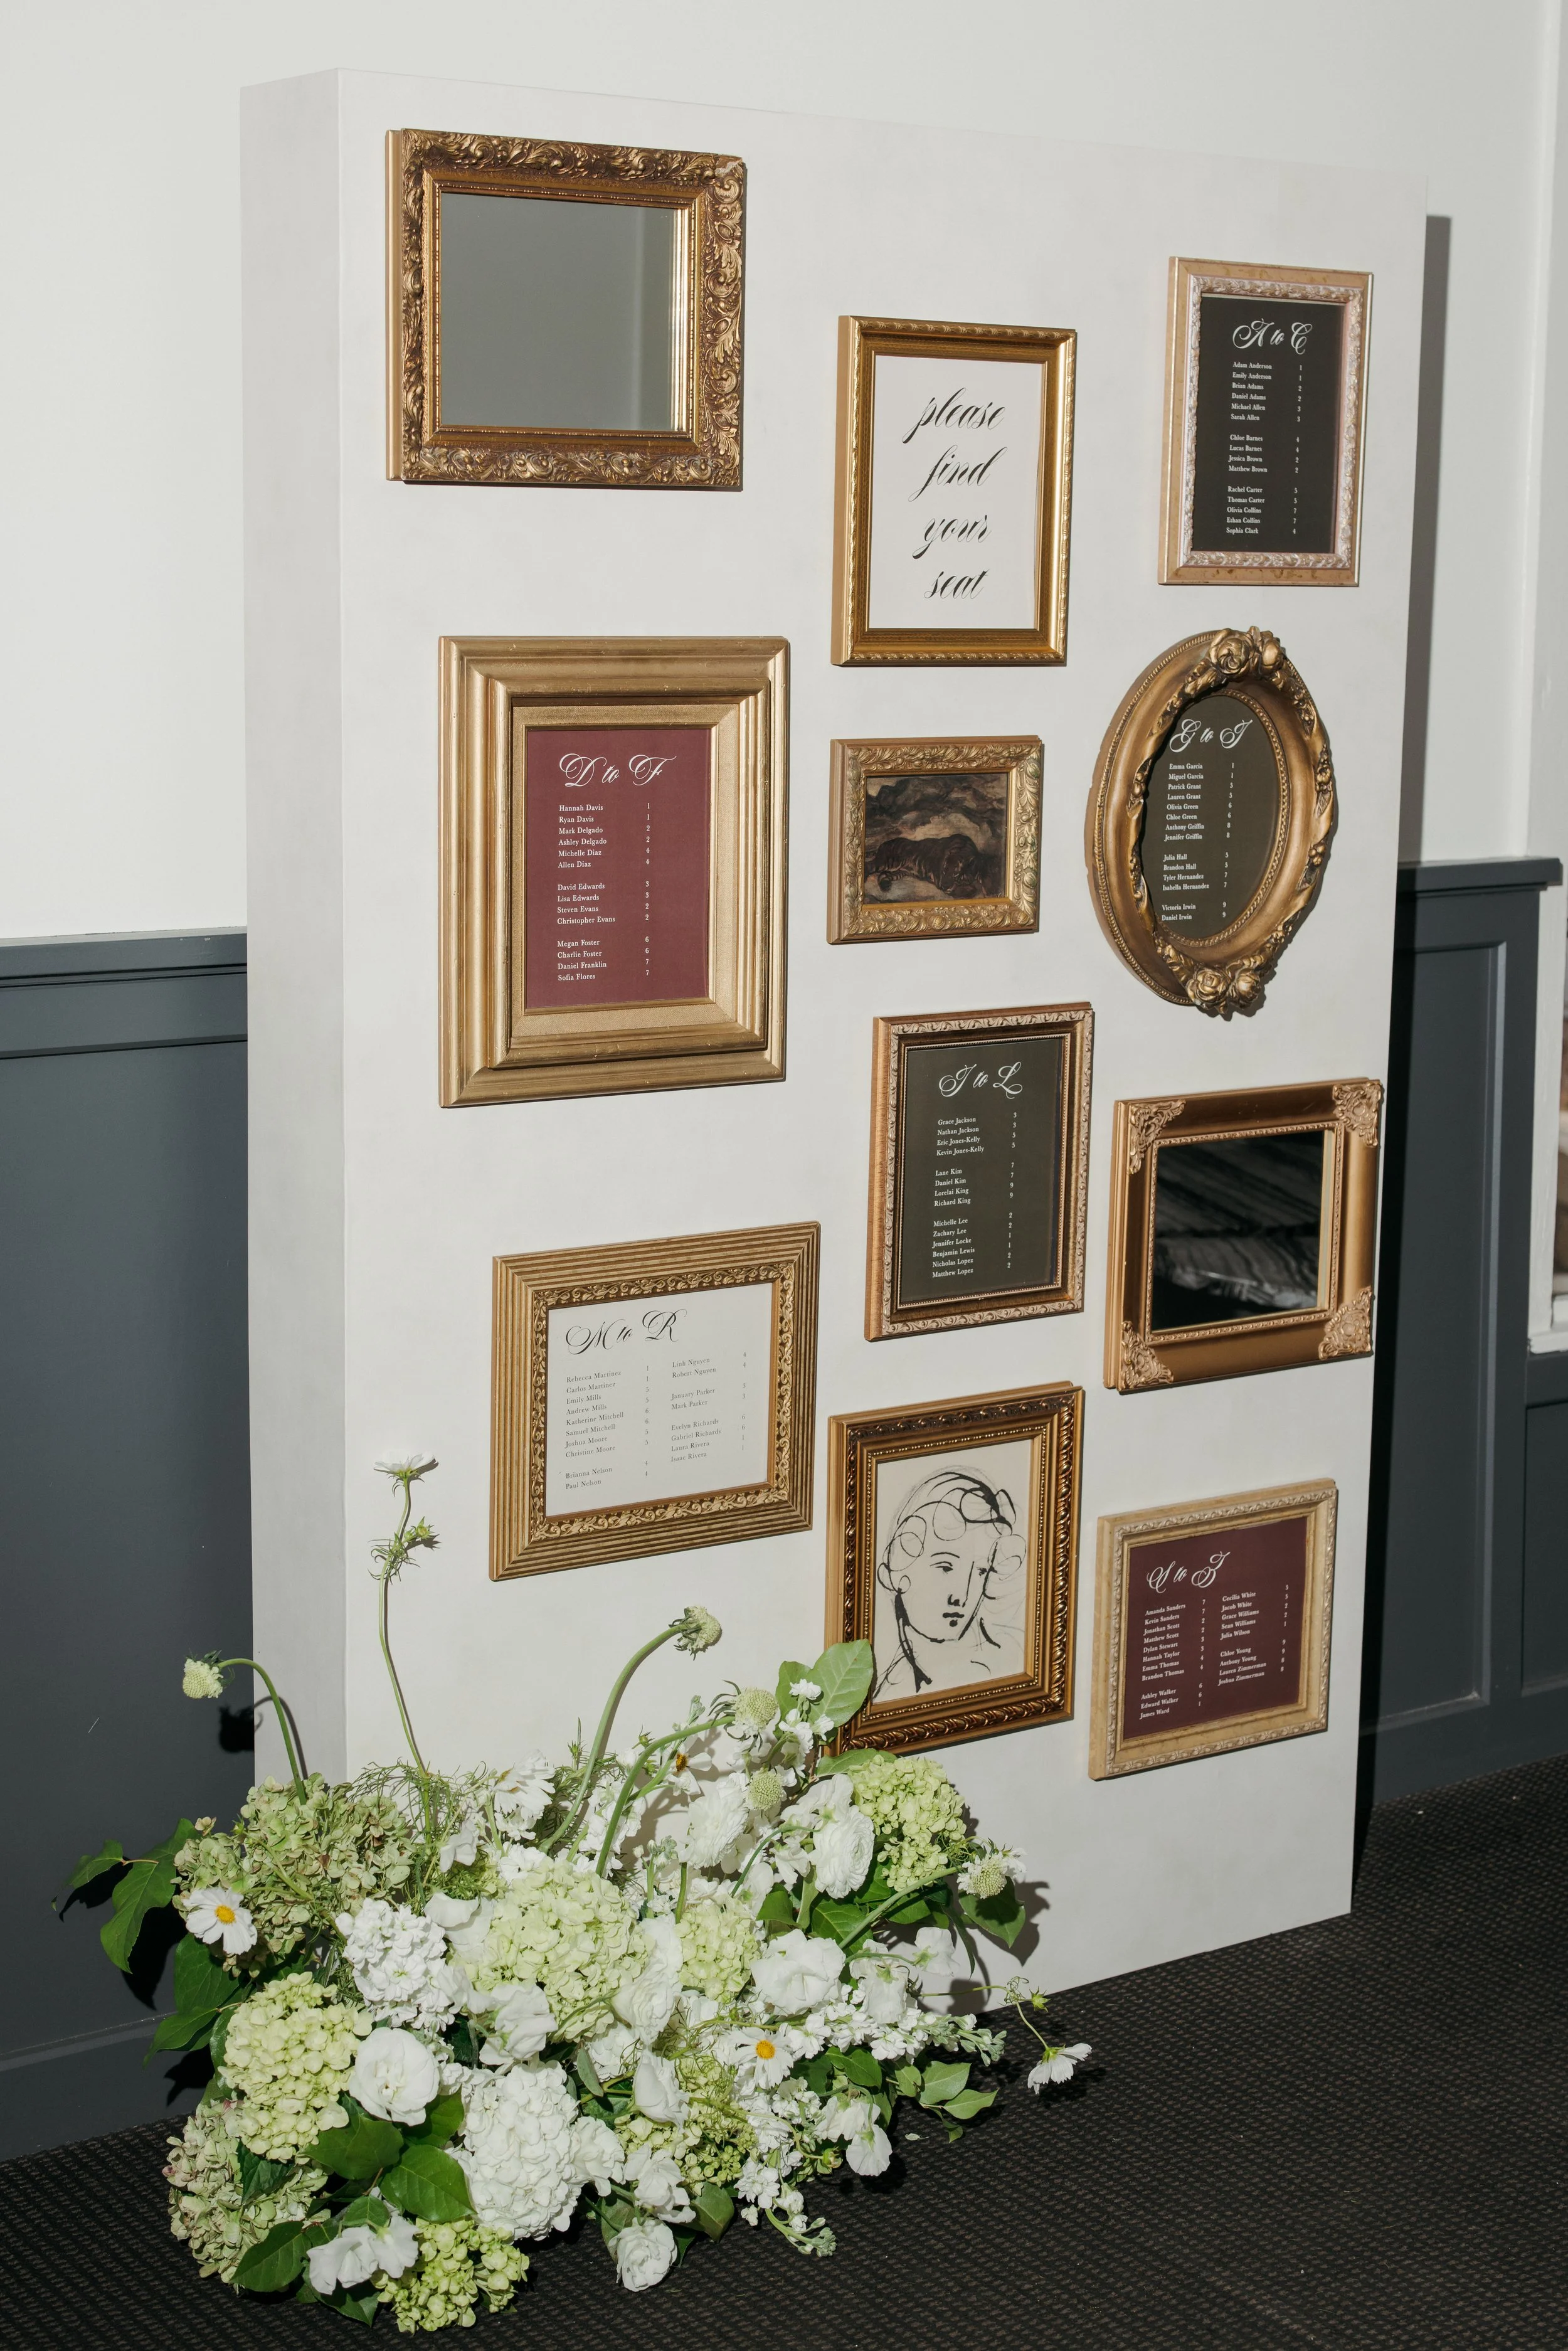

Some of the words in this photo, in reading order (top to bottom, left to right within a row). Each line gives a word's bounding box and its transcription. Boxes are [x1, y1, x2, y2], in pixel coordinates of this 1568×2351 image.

[1232, 318, 1274, 349] A
[1269, 329, 1285, 346] to
[1290, 322, 1313, 355] C
[1232, 371, 1248, 380] Emily
[901, 387, 1006, 444] please
[1227, 454, 1246, 463] Jessica
[908, 445, 1008, 502] find
[912, 514, 992, 560] your
[923, 568, 990, 600] seat
[1169, 718, 1202, 753] G
[1199, 727, 1214, 743] to
[559, 753, 607, 787] D
[601, 765, 620, 783] to
[628, 754, 677, 786] F
[1168, 773, 1186, 782] Miguel
[558, 816, 575, 825] Ryan
[577, 826, 603, 836] Delgado
[1165, 824, 1187, 832] Anthony
[558, 838, 580, 847] Ashley
[581, 837, 607, 846] Delgado
[1163, 834, 1185, 842] Jennifer
[1162, 874, 1177, 883] Tyler
[1177, 873, 1204, 881] Hernandez
[578, 882, 605, 890] Edwards
[557, 916, 595, 925] Christopher
[557, 940, 579, 948] Megan
[557, 962, 579, 970] Daniel
[580, 960, 607, 969] Franklin
[972, 1070, 988, 1088] to
[992, 1061, 1023, 1100] L
[954, 1117, 977, 1125] Jackson
[957, 1127, 979, 1135] Jackson
[948, 1135, 981, 1147] Jones-Kelly
[952, 1145, 985, 1156] Jones-Kelly
[934, 1188, 954, 1197] Lorelai
[934, 1198, 956, 1207] Richard
[933, 1219, 957, 1228] Michelle
[932, 1249, 958, 1258] Benjamin
[959, 1246, 975, 1255] Lewis
[932, 1260, 956, 1268] Nicholas
[565, 1319, 626, 1356] M
[616, 1325, 633, 1343] to
[642, 1308, 687, 1342] R
[672, 1360, 686, 1368] Linh
[687, 1358, 710, 1366] Nguyen
[566, 1375, 592, 1383] Rebecca
[594, 1371, 622, 1379] Martinez
[566, 1386, 586, 1394] Carlos
[588, 1382, 616, 1391] Martinez
[566, 1416, 597, 1426] Katherine
[598, 1411, 624, 1421] Mitchell
[693, 1418, 719, 1428] Richards
[671, 1432, 693, 1441] Gabriel
[695, 1428, 721, 1438] Richards
[566, 1440, 586, 1449] Joshua
[565, 1449, 594, 1458] Christine
[1146, 1561, 1176, 1594] S
[1173, 1566, 1188, 1583] to
